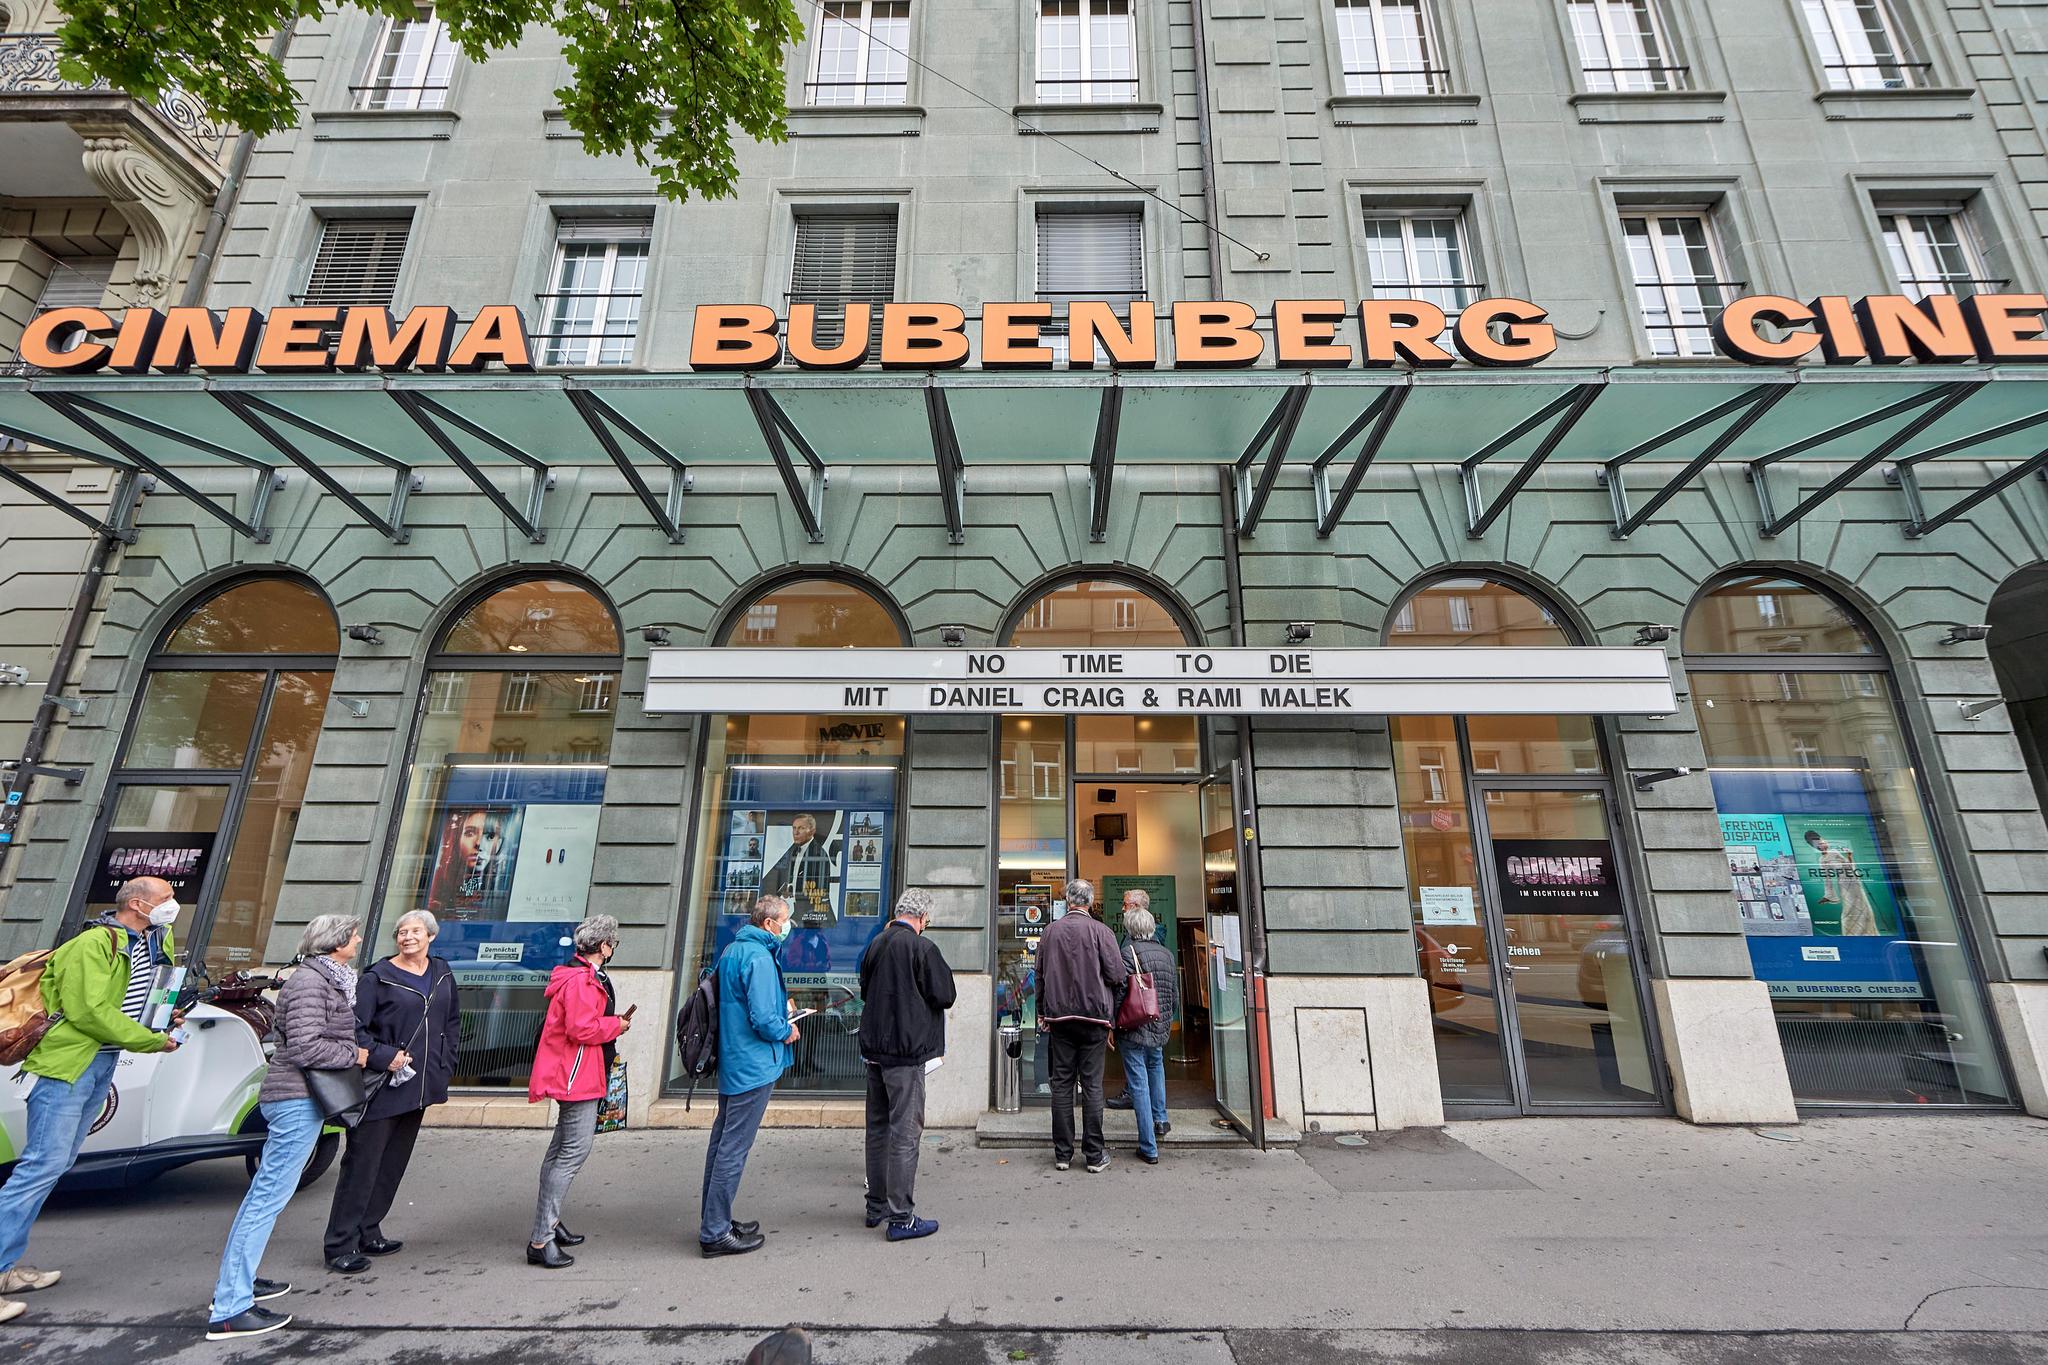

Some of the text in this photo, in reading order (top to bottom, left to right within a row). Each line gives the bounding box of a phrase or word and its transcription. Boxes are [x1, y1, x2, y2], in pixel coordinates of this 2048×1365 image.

[689, 298, 1558, 371] BUBENBERG
[1711, 293, 2048, 365] CINE
[19, 304, 537, 374] CINEMA
[968, 653, 1312, 674] NO TIME TO DIE
[844, 687, 1352, 708] MIT DANIEL CRAIG & RAMI MALEK
[1725, 820, 1774, 831] FRENCH
[1722, 831, 1781, 842] DISPATCH
[107, 848, 203, 876] QUINNIE
[1506, 856, 1606, 886] QUINNIE
[1808, 868, 1871, 878] RESPECT
[109, 880, 120, 888] IM
[1507, 946, 1541, 956] Ziehen
[462, 974, 551, 983] BUBENBERG CIN
[784, 976, 861, 985] ENBERG CINE
[1768, 985, 1918, 993] EMA BUBENBERG CINEBAR
